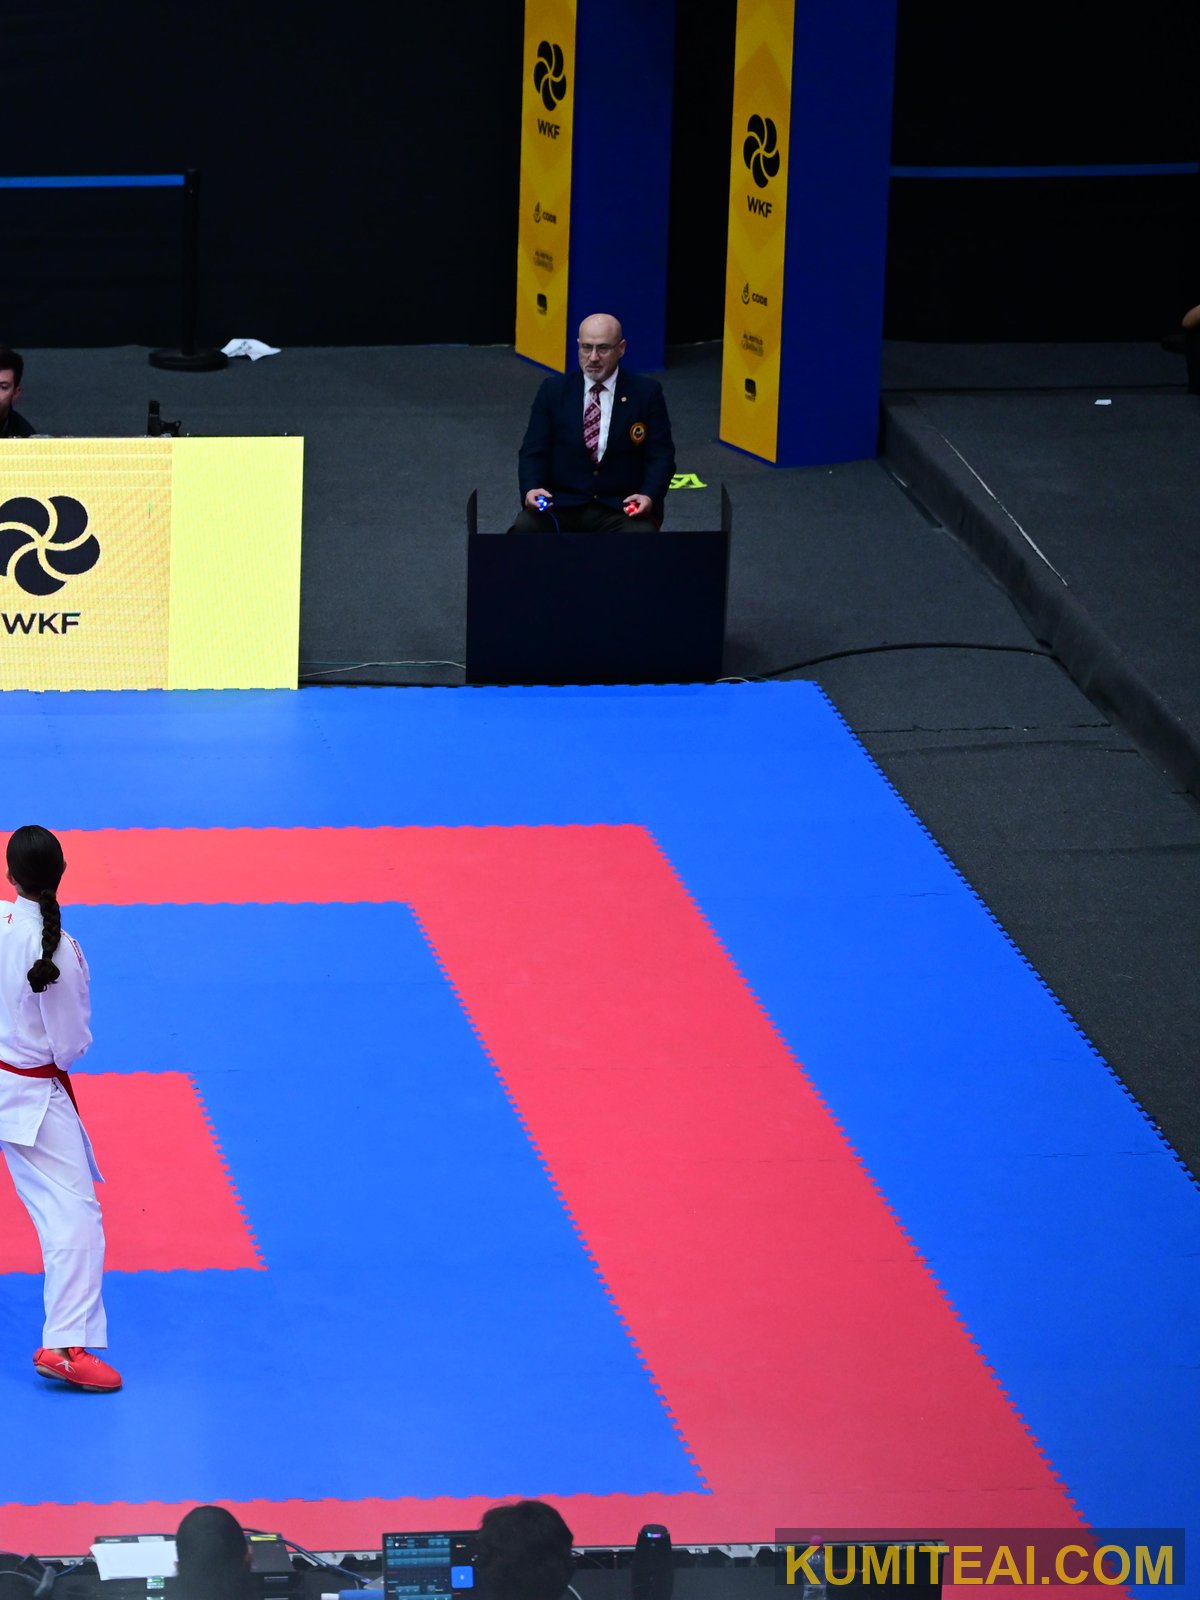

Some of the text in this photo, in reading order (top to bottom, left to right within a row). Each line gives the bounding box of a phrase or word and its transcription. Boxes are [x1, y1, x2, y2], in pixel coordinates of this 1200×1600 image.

[537, 118, 560, 140] WKF
[747, 195, 772, 218] WKF
[752, 293, 768, 306] CODE
[1, 612, 81, 635] WKF
